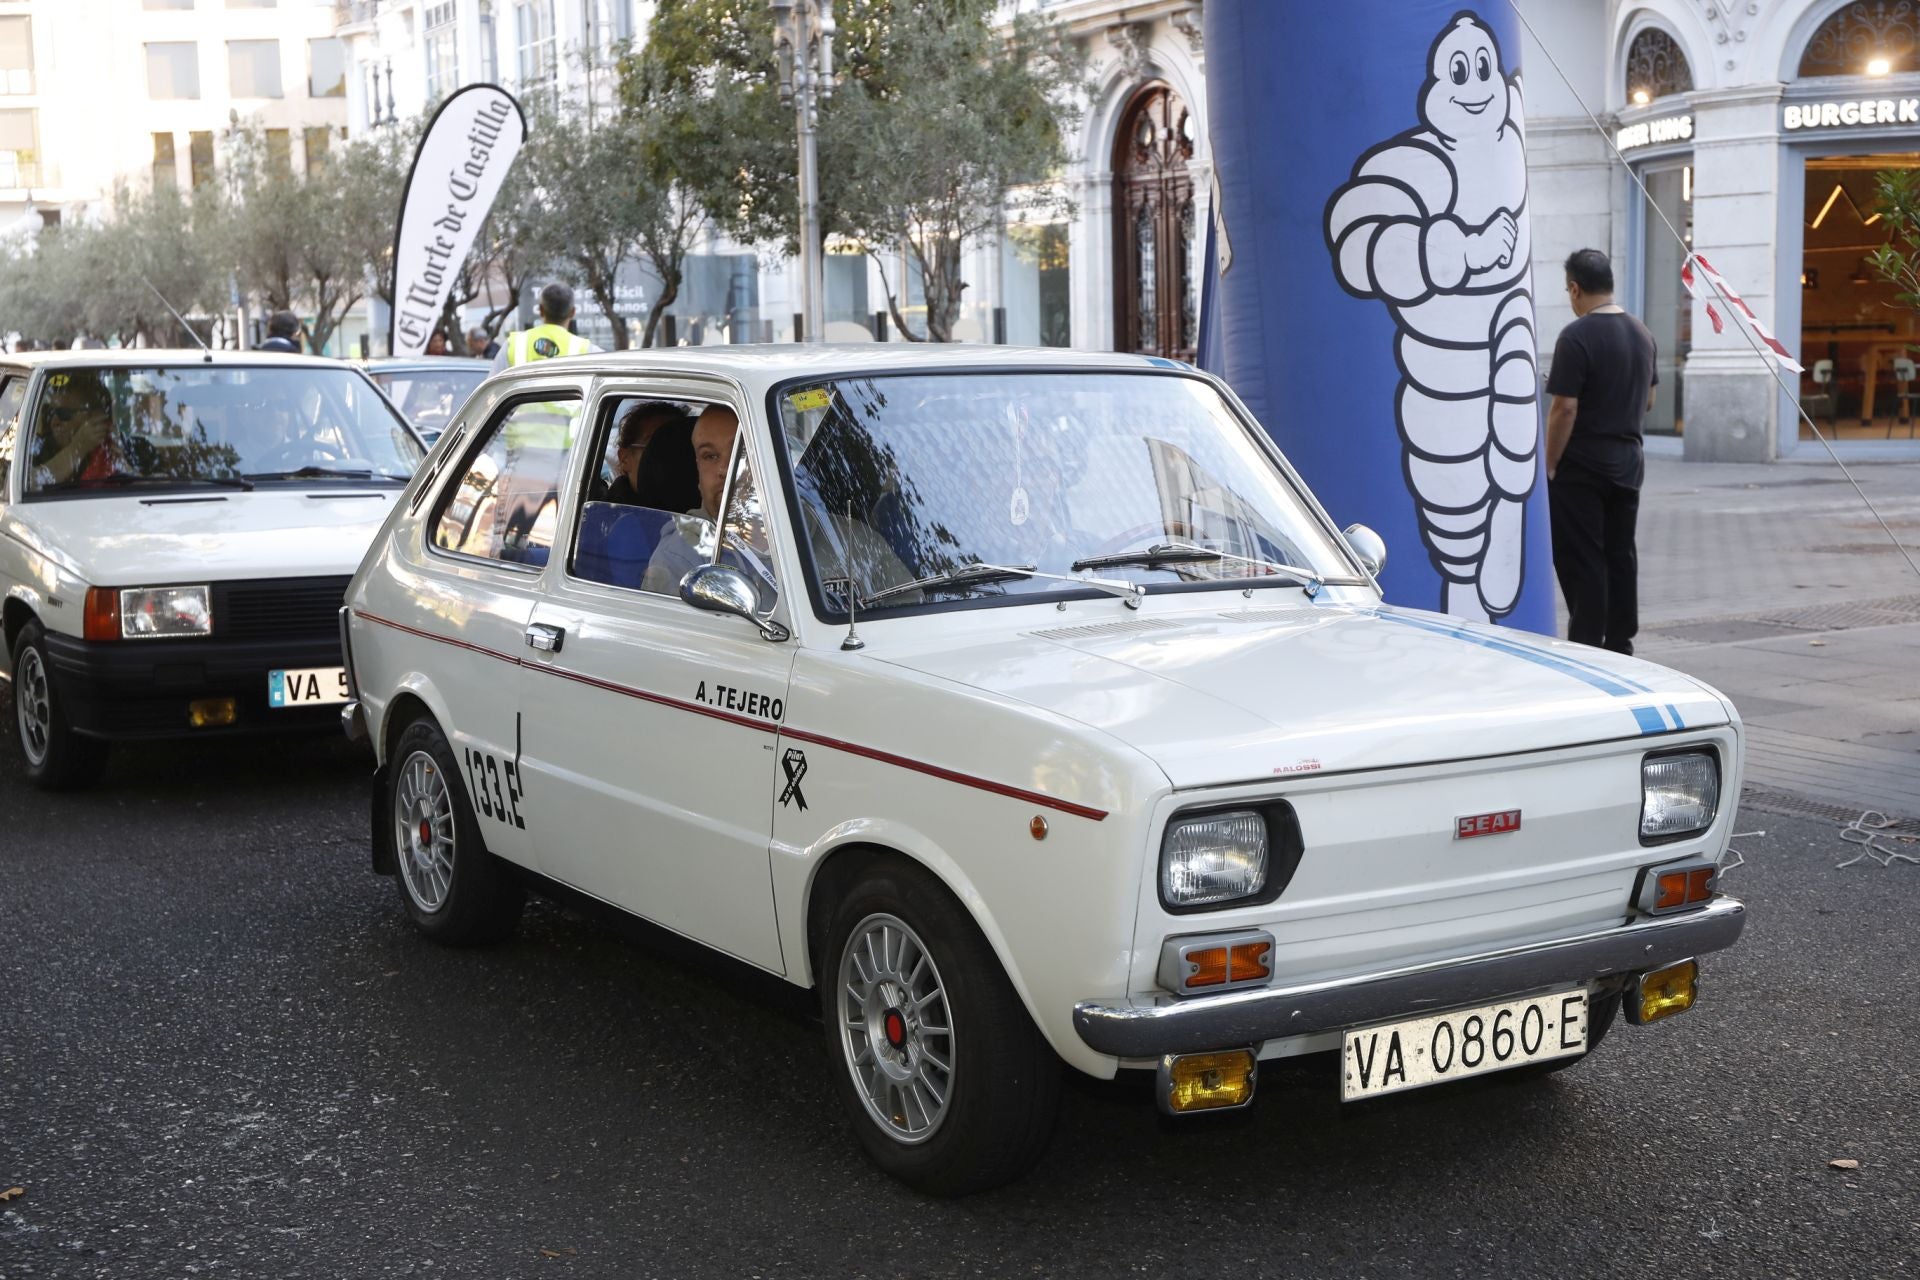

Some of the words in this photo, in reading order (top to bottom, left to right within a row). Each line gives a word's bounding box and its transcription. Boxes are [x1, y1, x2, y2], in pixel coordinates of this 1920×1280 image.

[1784, 101, 1895, 129] BURGER
[448, 99, 511, 201] Castilla
[433, 203, 468, 233] de
[405, 234, 455, 309] Norte
[398, 311, 431, 349] El
[286, 674, 321, 701] VA
[1273, 763, 1321, 774] MALOSSI
[1460, 812, 1519, 833] SEAT
